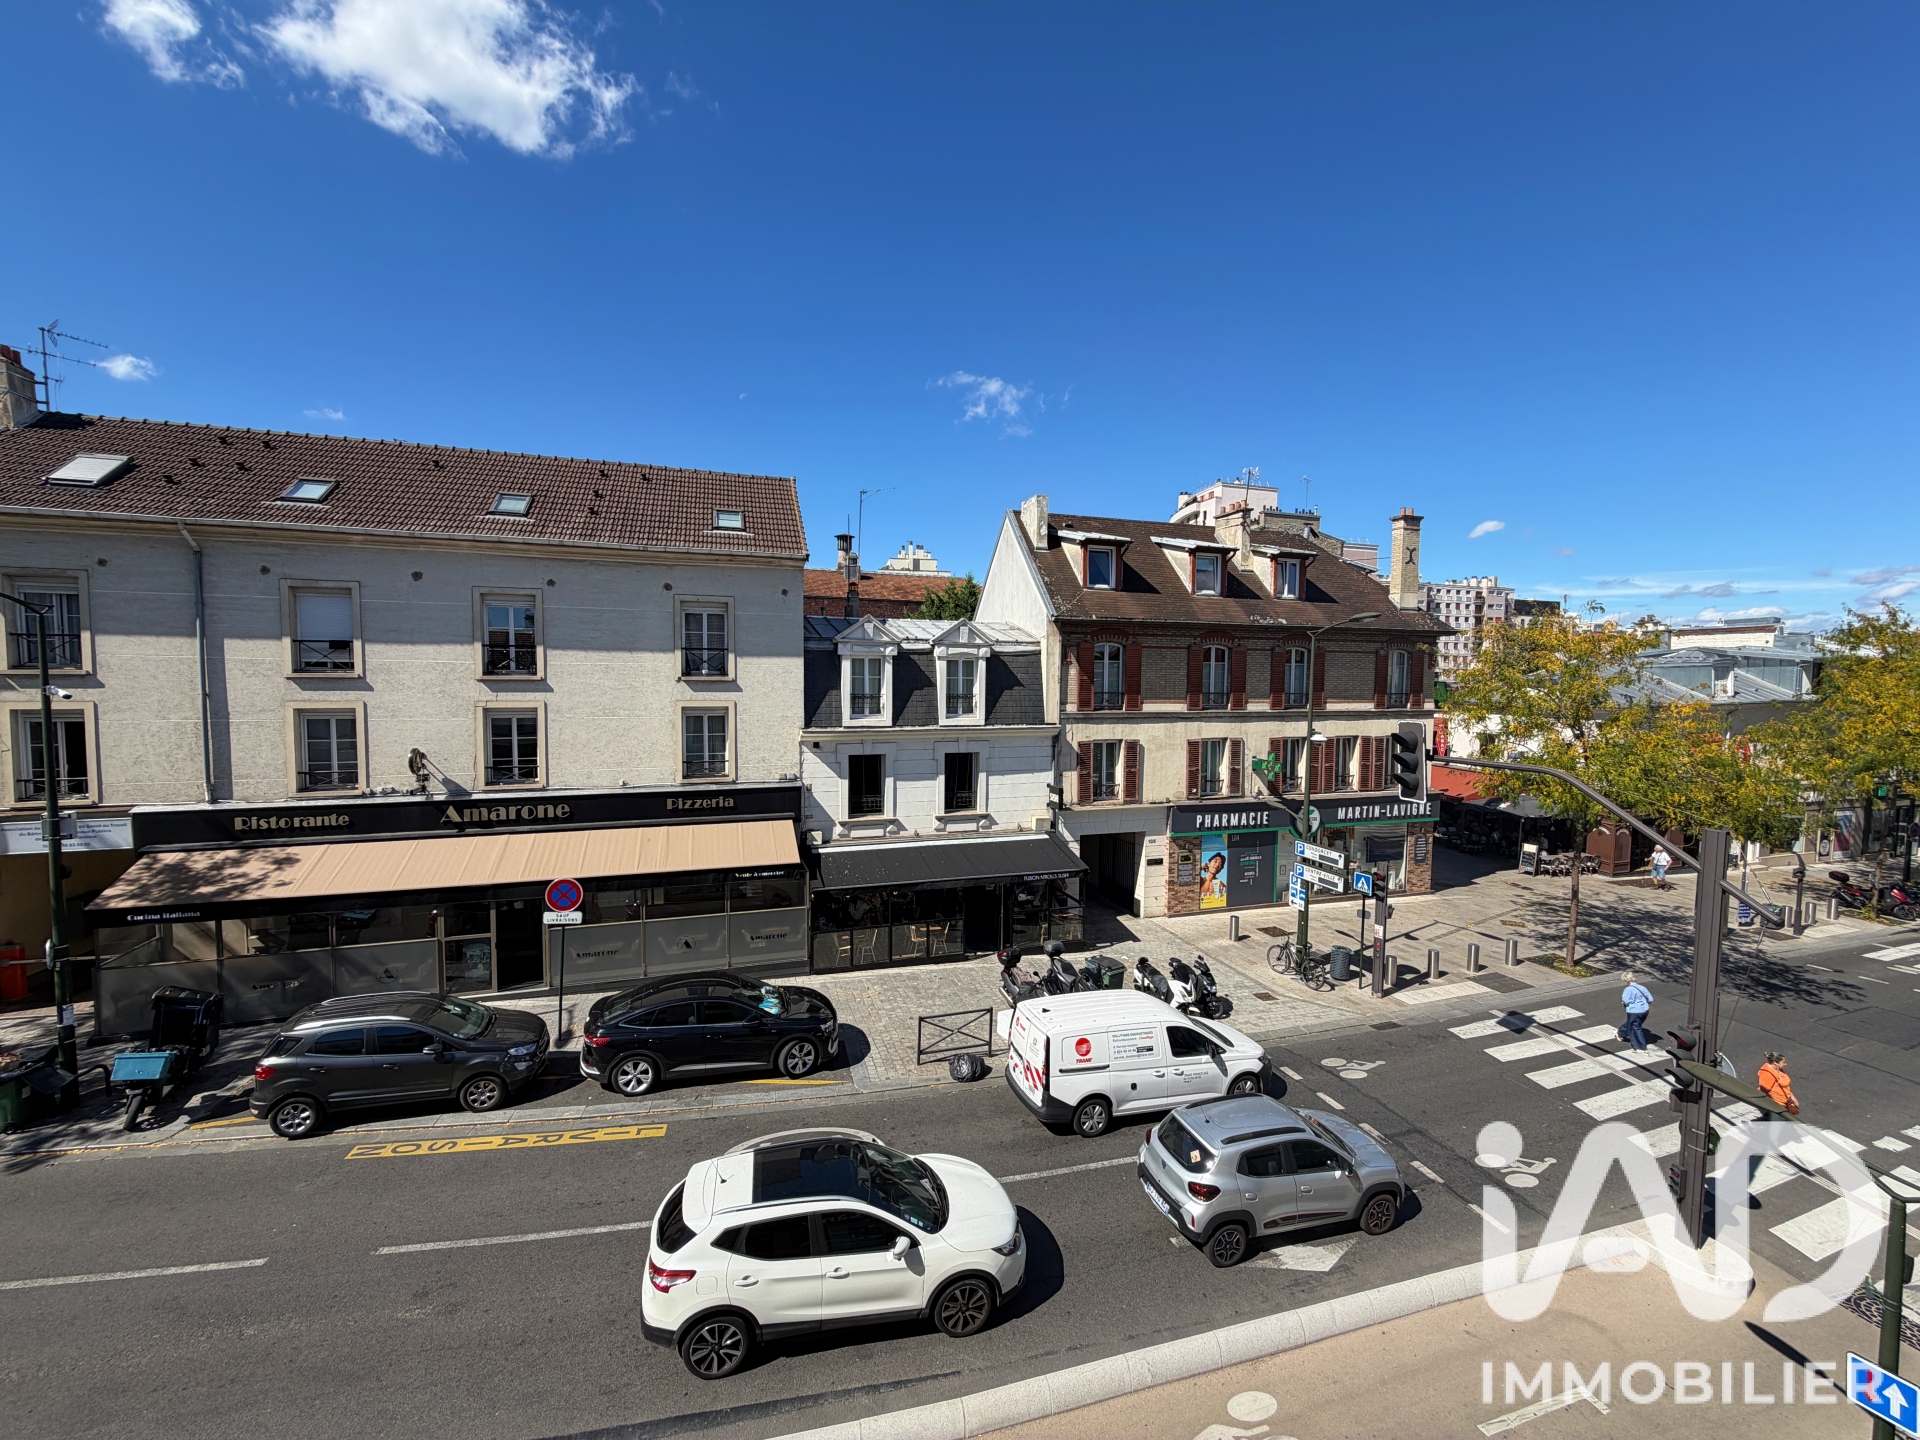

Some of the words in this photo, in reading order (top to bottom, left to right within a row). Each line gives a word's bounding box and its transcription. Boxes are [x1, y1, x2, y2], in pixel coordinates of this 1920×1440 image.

[666, 796, 734, 810] Pizzeria
[1337, 802, 1432, 820] MARTIN-LAVIGNE
[234, 813, 350, 831] Ristorante
[440, 802, 571, 824] Amarone
[1196, 811, 1269, 829] PHARMACIE
[1297, 843, 1304, 854] P
[1306, 844, 1332, 856] CONDORCET
[1296, 864, 1303, 875] P
[1305, 867, 1336, 881] CENTRE-VILLE
[127, 913, 161, 921] Cucina
[162, 911, 200, 919] italiana
[351, 1125, 664, 1157] LIVRAISON
